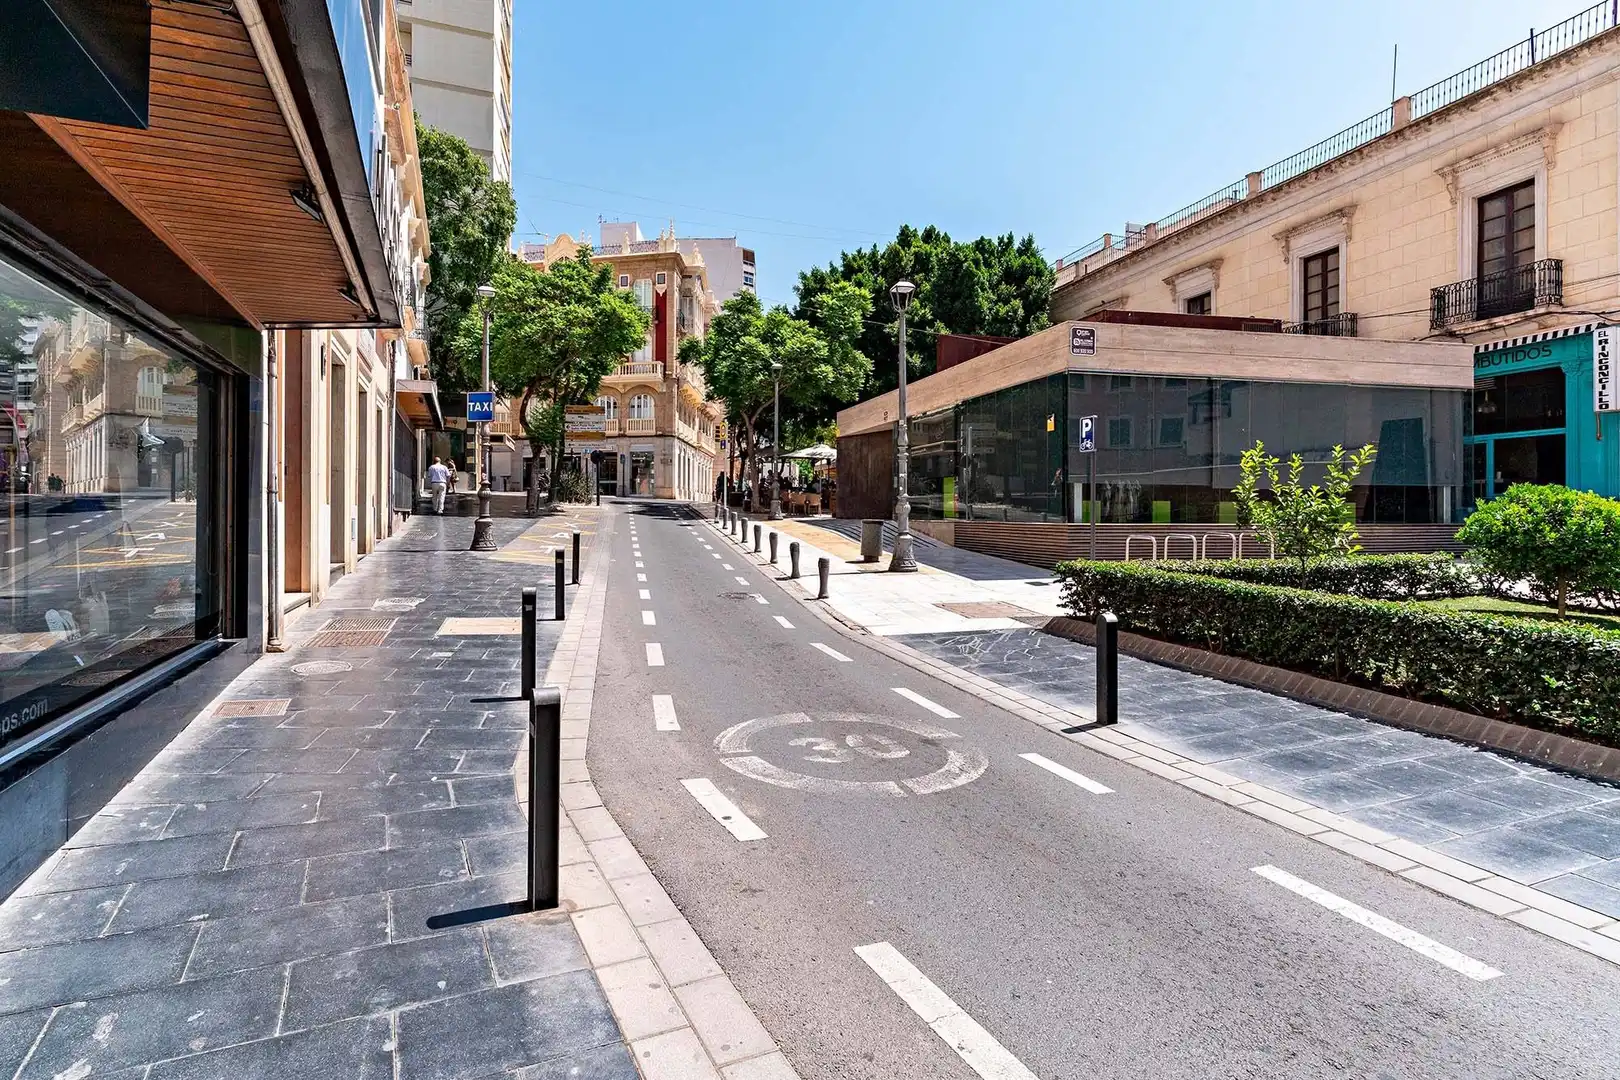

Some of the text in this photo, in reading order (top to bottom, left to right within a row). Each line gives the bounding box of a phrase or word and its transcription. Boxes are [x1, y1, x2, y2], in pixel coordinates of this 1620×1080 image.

[1598, 330, 1609, 338] EL
[1598, 338, 1609, 410] RINCONCILLO
[468, 402, 493, 411] TAXI
[1082, 418, 1092, 438] P
[0, 699, 48, 739] ps.com
[788, 734, 911, 763] 30
